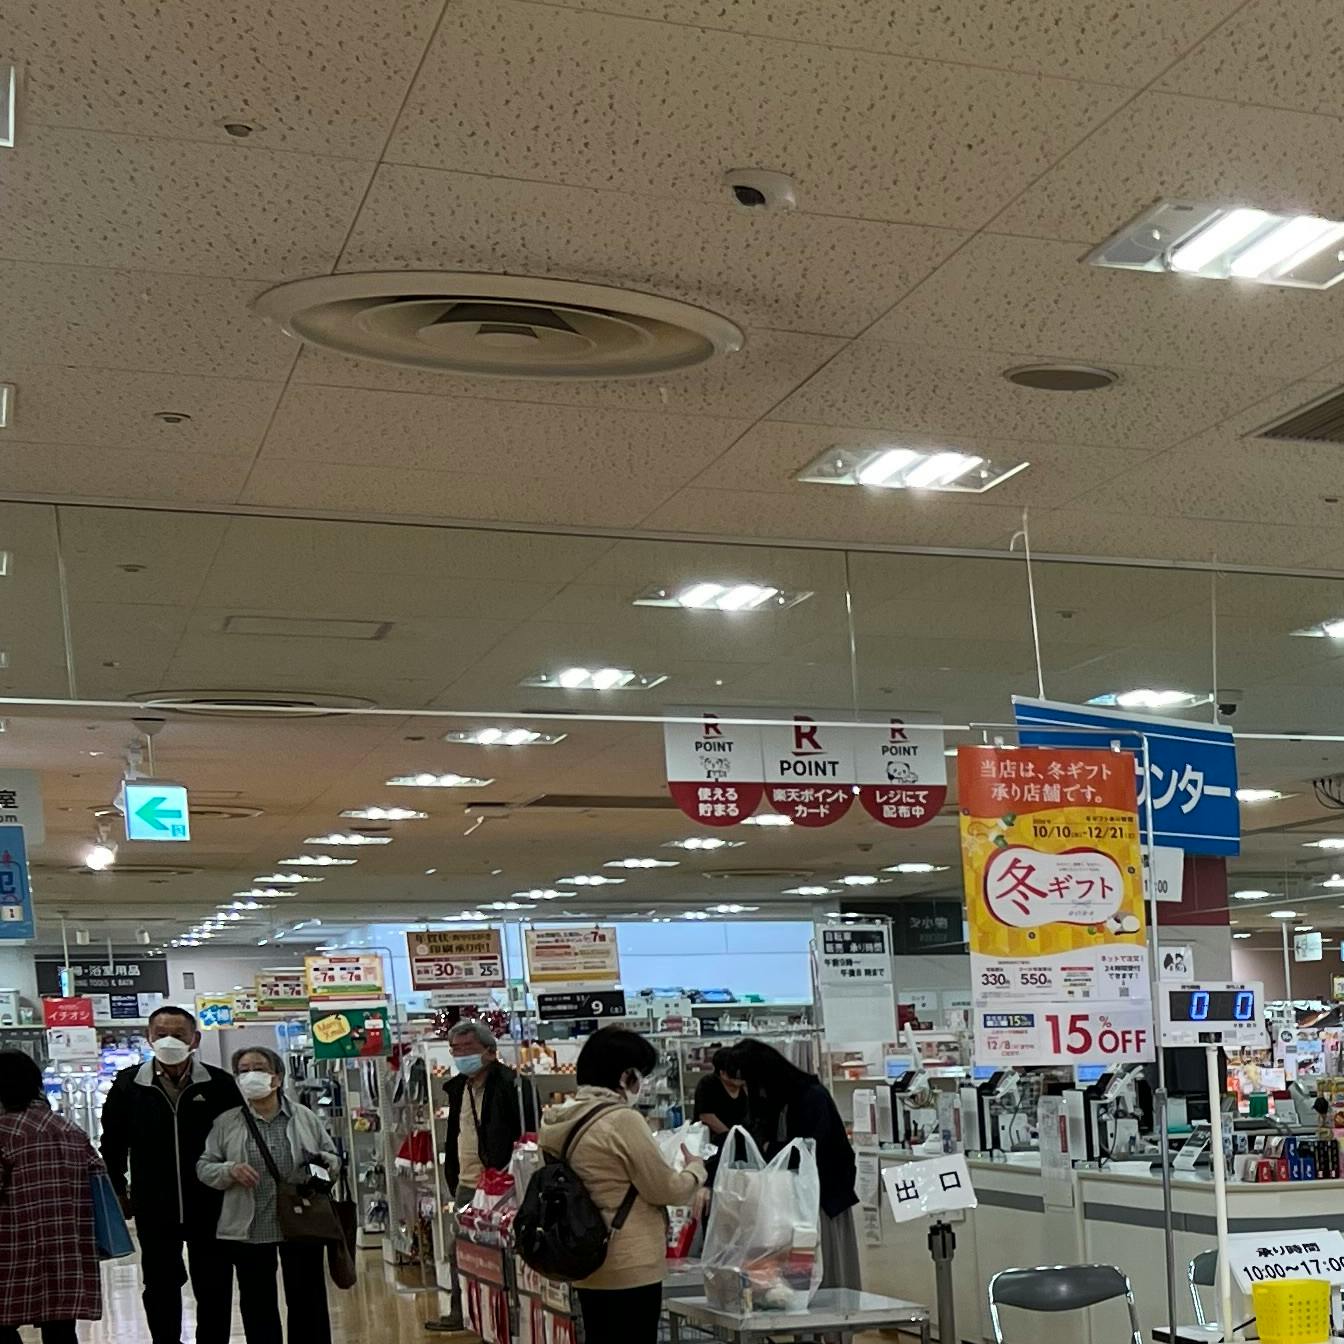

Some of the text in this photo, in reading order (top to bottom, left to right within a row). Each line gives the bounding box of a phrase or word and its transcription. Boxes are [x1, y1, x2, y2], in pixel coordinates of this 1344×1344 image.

[695, 741, 733, 752] POINT
[881, 746, 918, 756] POINT
[780, 760, 839, 776] POINT
[980, 759, 1112, 781] 当店は、冬ギフト
[698, 787, 738, 801] 使える
[773, 788, 848, 803] 楽天ポイント
[875, 790, 928, 804] レジにて
[991, 783, 1103, 804] 承り店舗です。
[699, 803, 739, 816] 貯まる
[795, 804, 829, 818] カード
[883, 806, 925, 818] 配布中
[995, 857, 1114, 916] 冬ギフト
[1144, 879, 1168, 893] 1:00
[1190, 991, 1254, 1020] 0 0
[1045, 1014, 1147, 1055] 15 % OFF
[1256, 1242, 1321, 1257] 承り時間
